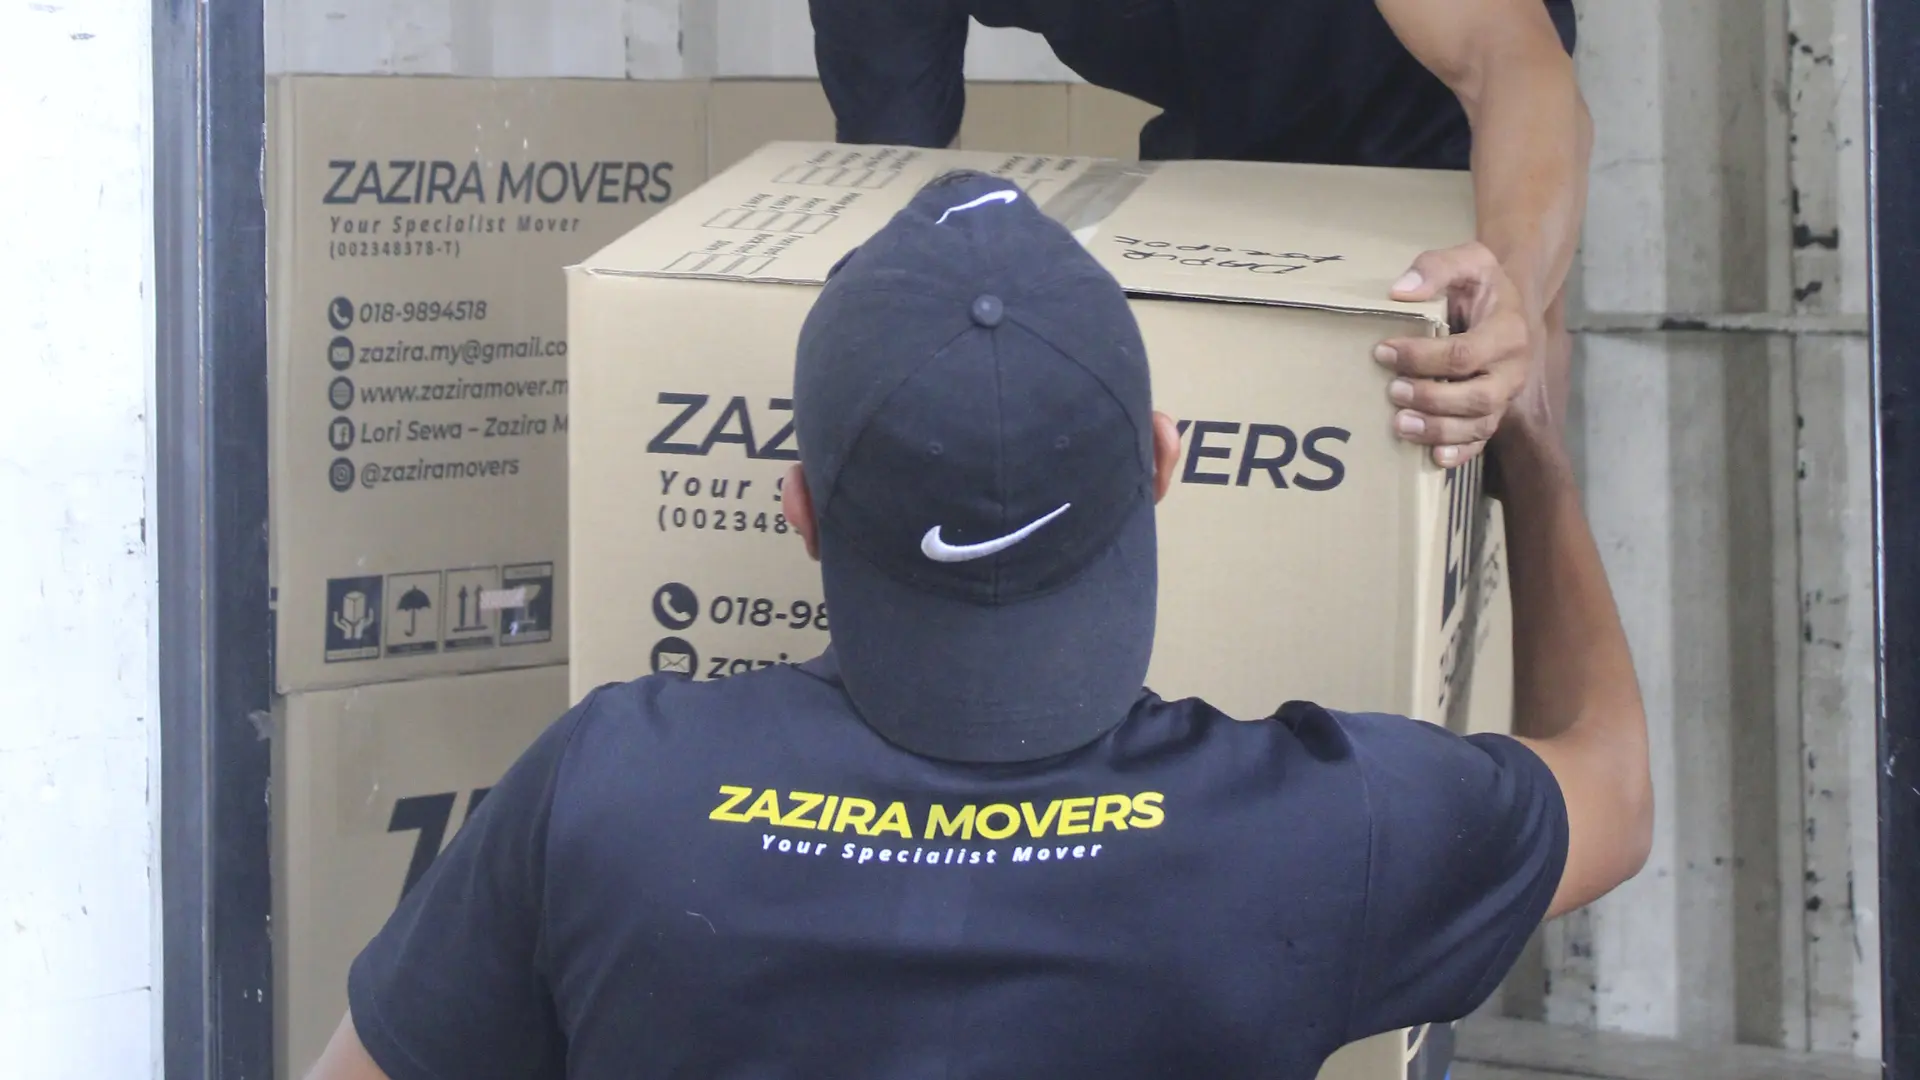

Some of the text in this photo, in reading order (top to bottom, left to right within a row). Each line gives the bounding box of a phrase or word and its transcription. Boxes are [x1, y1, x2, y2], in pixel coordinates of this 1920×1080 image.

[323, 160, 674, 204] ZAZIRA MOVERS
[330, 215, 581, 237] Your Specialist Mover
[360, 301, 487, 323] 018-9894518
[359, 336, 567, 365] zazira.my@gmail.co
[360, 378, 567, 403] www.zaziramover.m
[361, 420, 401, 444] Lori
[407, 420, 462, 441] Sewa
[483, 414, 547, 438] Zazira
[646, 392, 1352, 492] ZAZ ERS
[361, 457, 520, 489] @zaziramovers
[660, 470, 752, 499] Your
[658, 504, 799, 535] (002348
[710, 596, 830, 631] 018-98
[709, 784, 1165, 840] ZAZIRA MOVERS
[761, 834, 1103, 865] Your Specialist Mover
